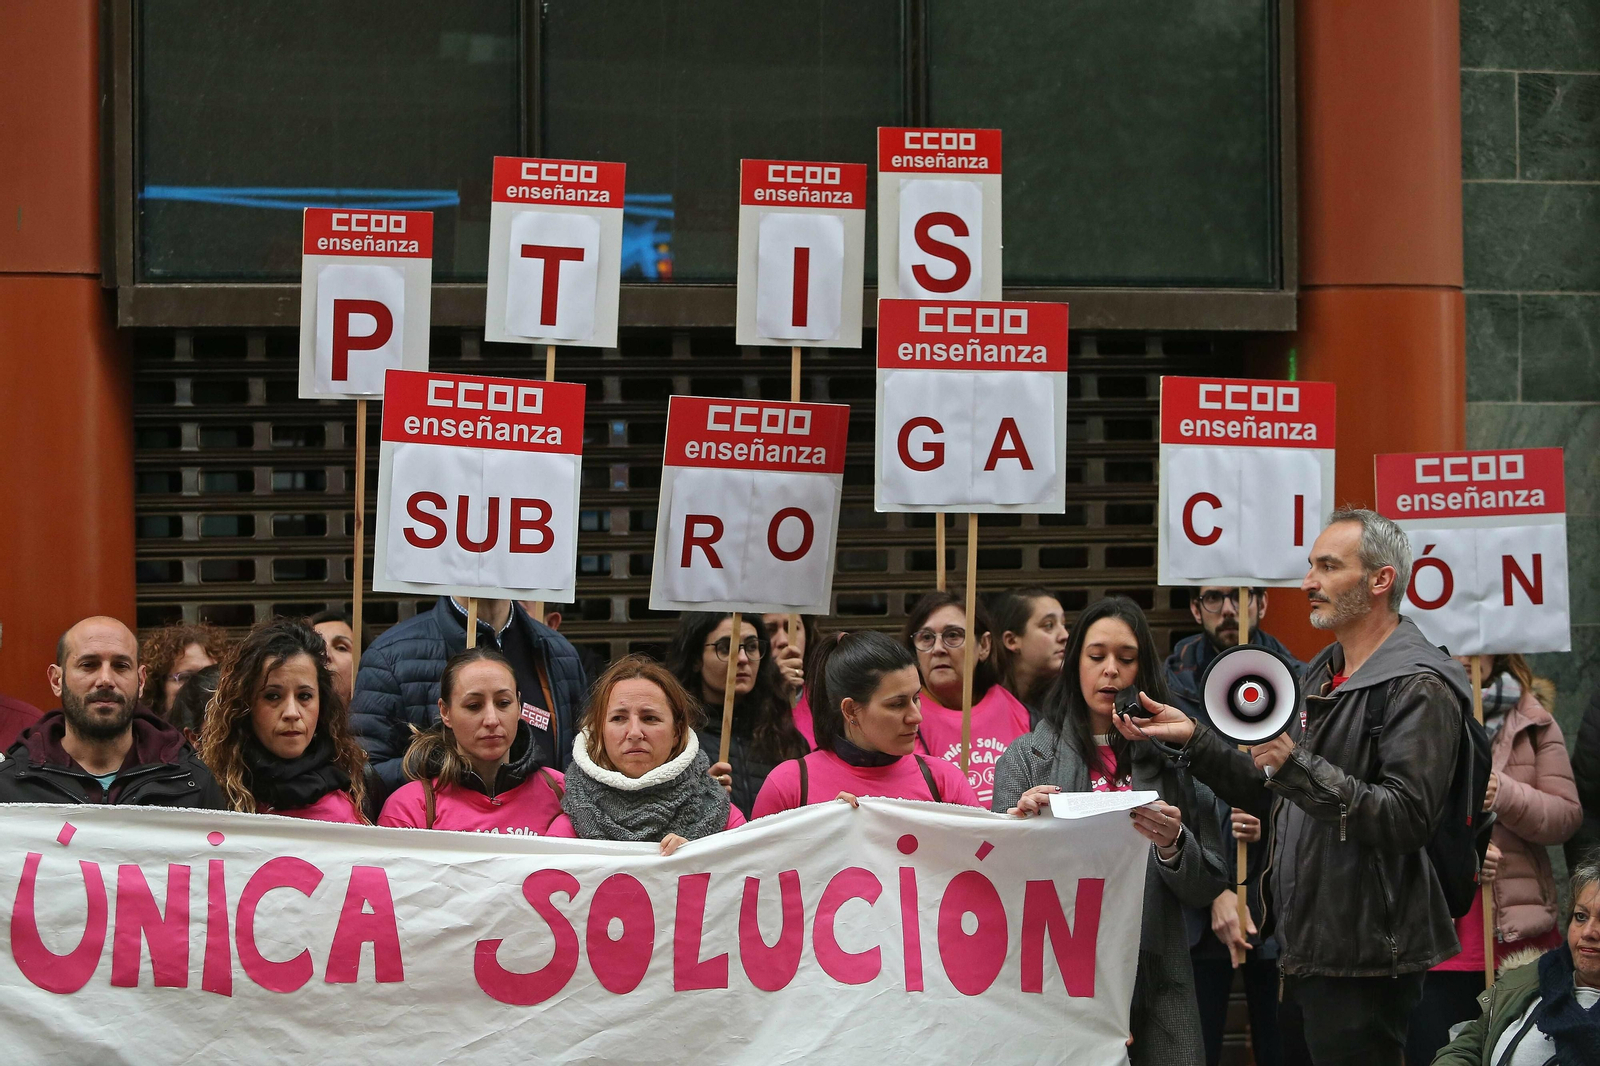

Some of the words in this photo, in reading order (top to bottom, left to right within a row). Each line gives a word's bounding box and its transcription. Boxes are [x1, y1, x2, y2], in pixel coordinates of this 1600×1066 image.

[904, 131, 976, 151] CCOO
[521, 162, 598, 184] CCOO
[768, 165, 841, 185] CCOO
[891, 152, 989, 170] enseñanza
[505, 183, 611, 203] enseñanza
[753, 187, 853, 205] enseñanza
[331, 213, 407, 233] CCOO
[317, 235, 420, 254] enseñanza
[912, 211, 972, 293] S
[520, 244, 585, 326] T
[791, 246, 811, 327] I
[918, 306, 1028, 334] CCOO
[331, 298, 394, 381] P
[897, 338, 1048, 364] enseñanza
[427, 379, 544, 415] CCOO
[1198, 383, 1300, 413] CCOO
[403, 412, 563, 446] enseñanza
[706, 404, 813, 436] CCOO
[1179, 414, 1318, 441] enseñanza
[684, 437, 827, 465] enseñanza
[1415, 454, 1526, 484] CCOO
[1396, 484, 1546, 512] enseñanza
[403, 490, 555, 554] SUB
